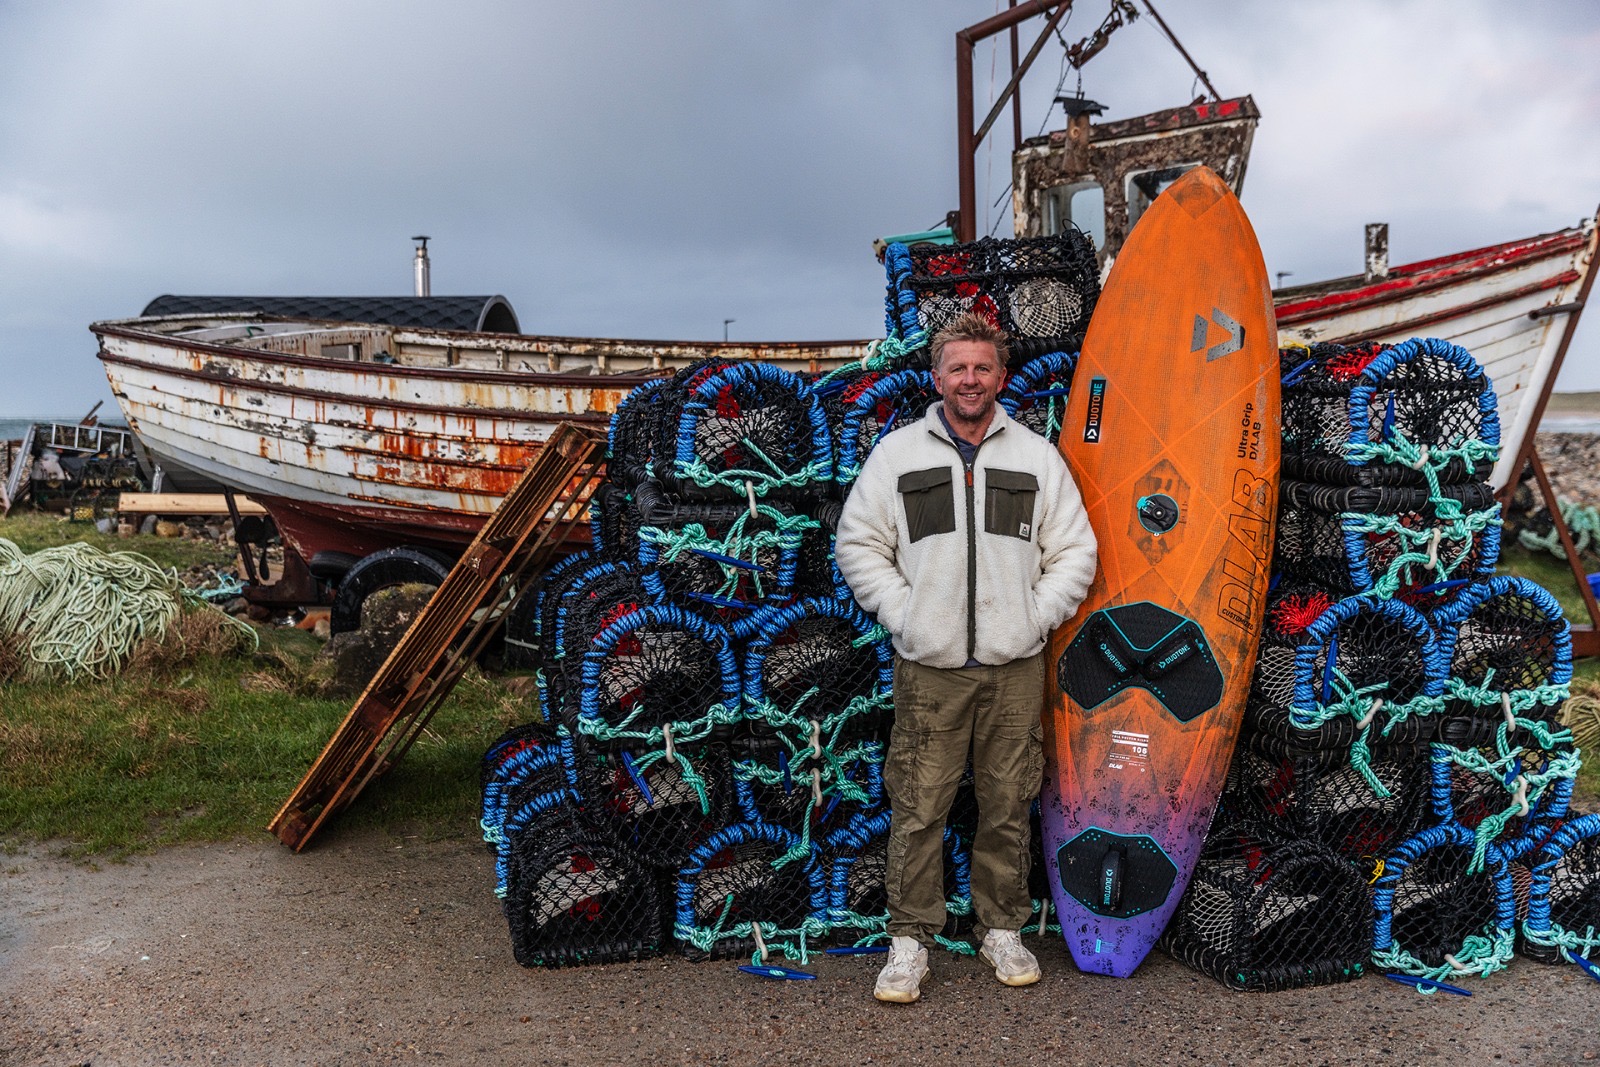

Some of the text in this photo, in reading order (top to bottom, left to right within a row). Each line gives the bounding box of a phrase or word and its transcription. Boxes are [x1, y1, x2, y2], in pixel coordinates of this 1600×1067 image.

[1089, 383, 1103, 426] DUOTONE
[1237, 402, 1254, 458] Ultra Grip
[1249, 421, 1262, 460] D/LAB
[1104, 648, 1127, 673] DUOTONE
[1165, 644, 1191, 665] DUOTONE
[1103, 877, 1113, 905] DUOTONE
